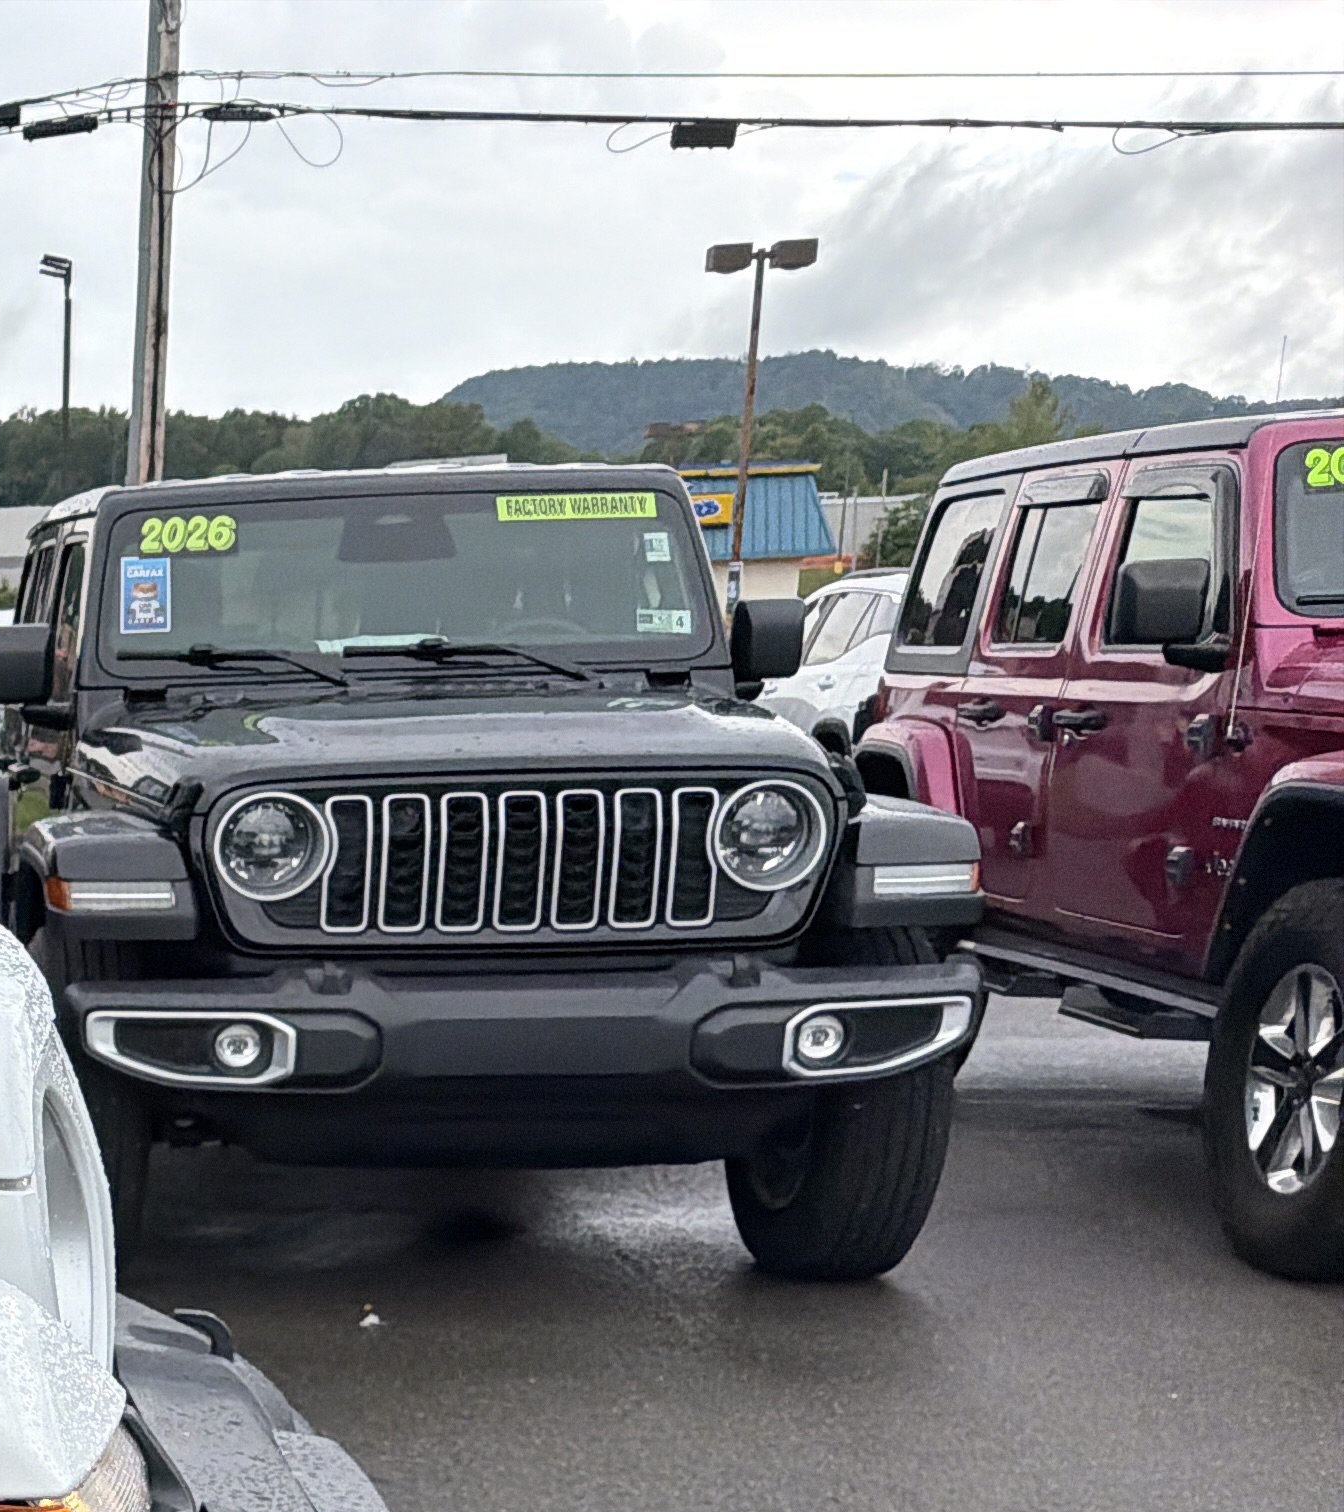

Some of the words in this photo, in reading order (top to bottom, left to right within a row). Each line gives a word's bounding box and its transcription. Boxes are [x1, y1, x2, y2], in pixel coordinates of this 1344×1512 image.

[506, 497, 566, 517] FACTORY
[569, 495, 648, 515] WARRANTY
[140, 515, 237, 553] 2026
